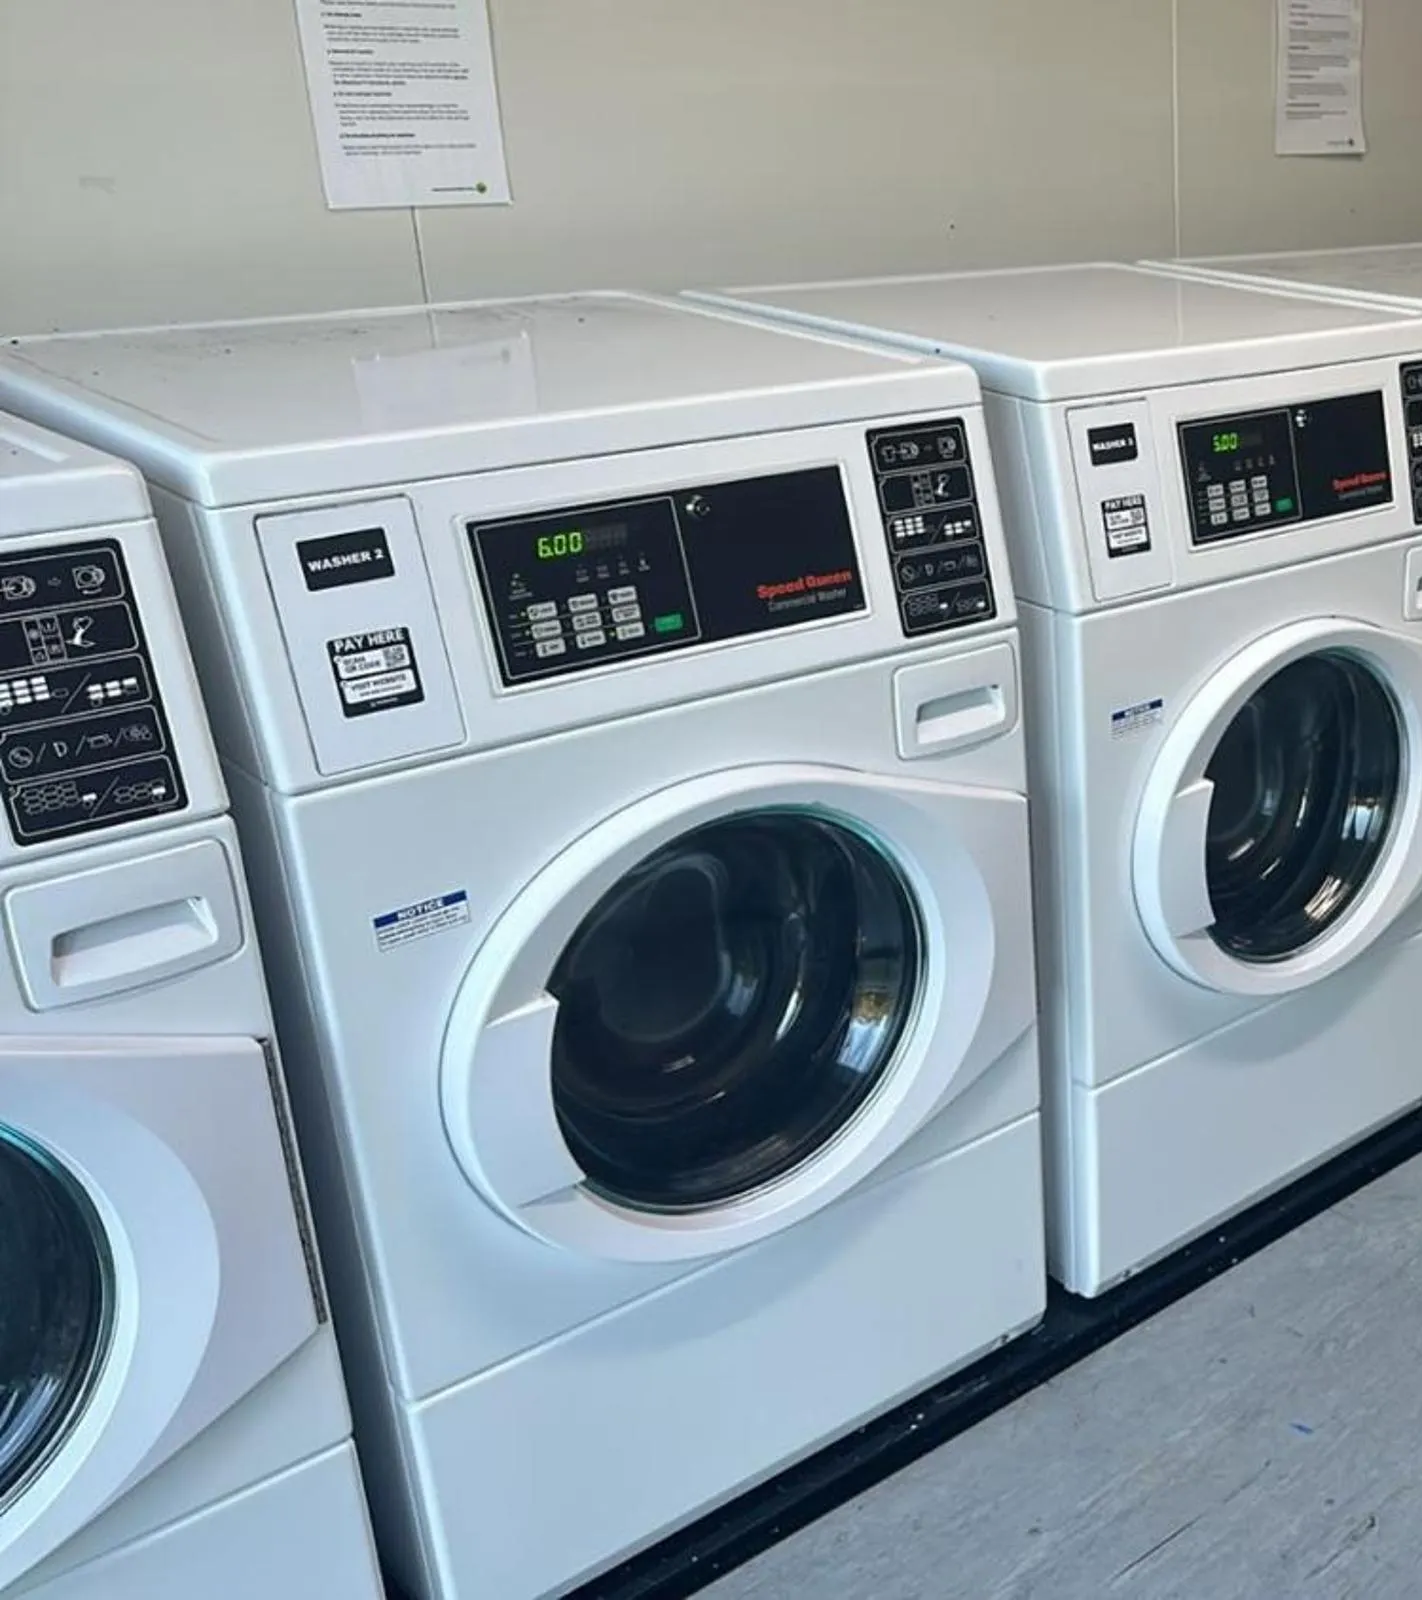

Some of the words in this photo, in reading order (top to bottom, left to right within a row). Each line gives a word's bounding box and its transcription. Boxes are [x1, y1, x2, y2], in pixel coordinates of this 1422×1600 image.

[307, 551, 373, 573] WASHER
[375, 548, 385, 559] 2
[756, 577, 805, 602] Speed
[805, 569, 852, 588] Queen
[333, 635, 366, 653] PAY
[367, 628, 405, 647] HERE
